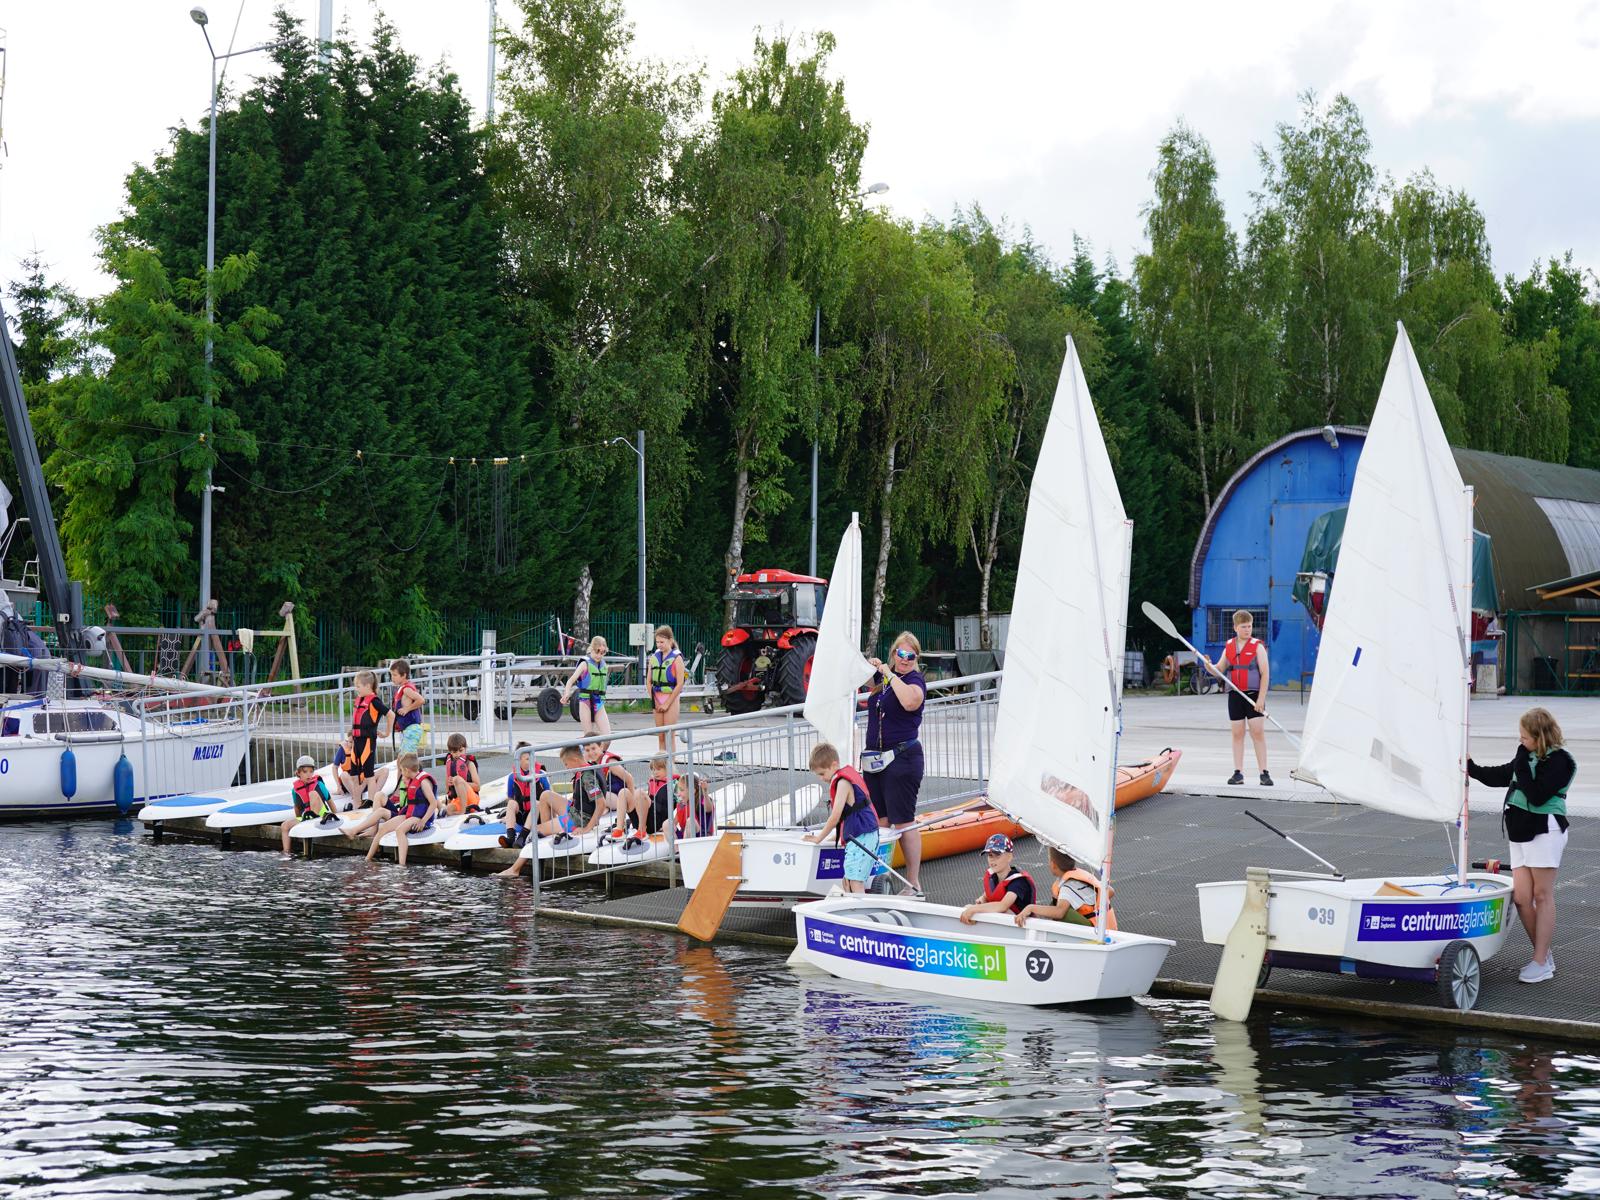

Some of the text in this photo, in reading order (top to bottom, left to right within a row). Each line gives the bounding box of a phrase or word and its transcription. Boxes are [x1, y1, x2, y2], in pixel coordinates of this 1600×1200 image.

[0, 758, 9, 774] 0
[784, 852, 797, 866] 31
[1319, 907, 1335, 925] 39
[1401, 902, 1503, 934] centrumzeglarskie.pl
[840, 933, 1000, 975] centrumzeglarskie.pl
[1028, 957, 1050, 975] 37
